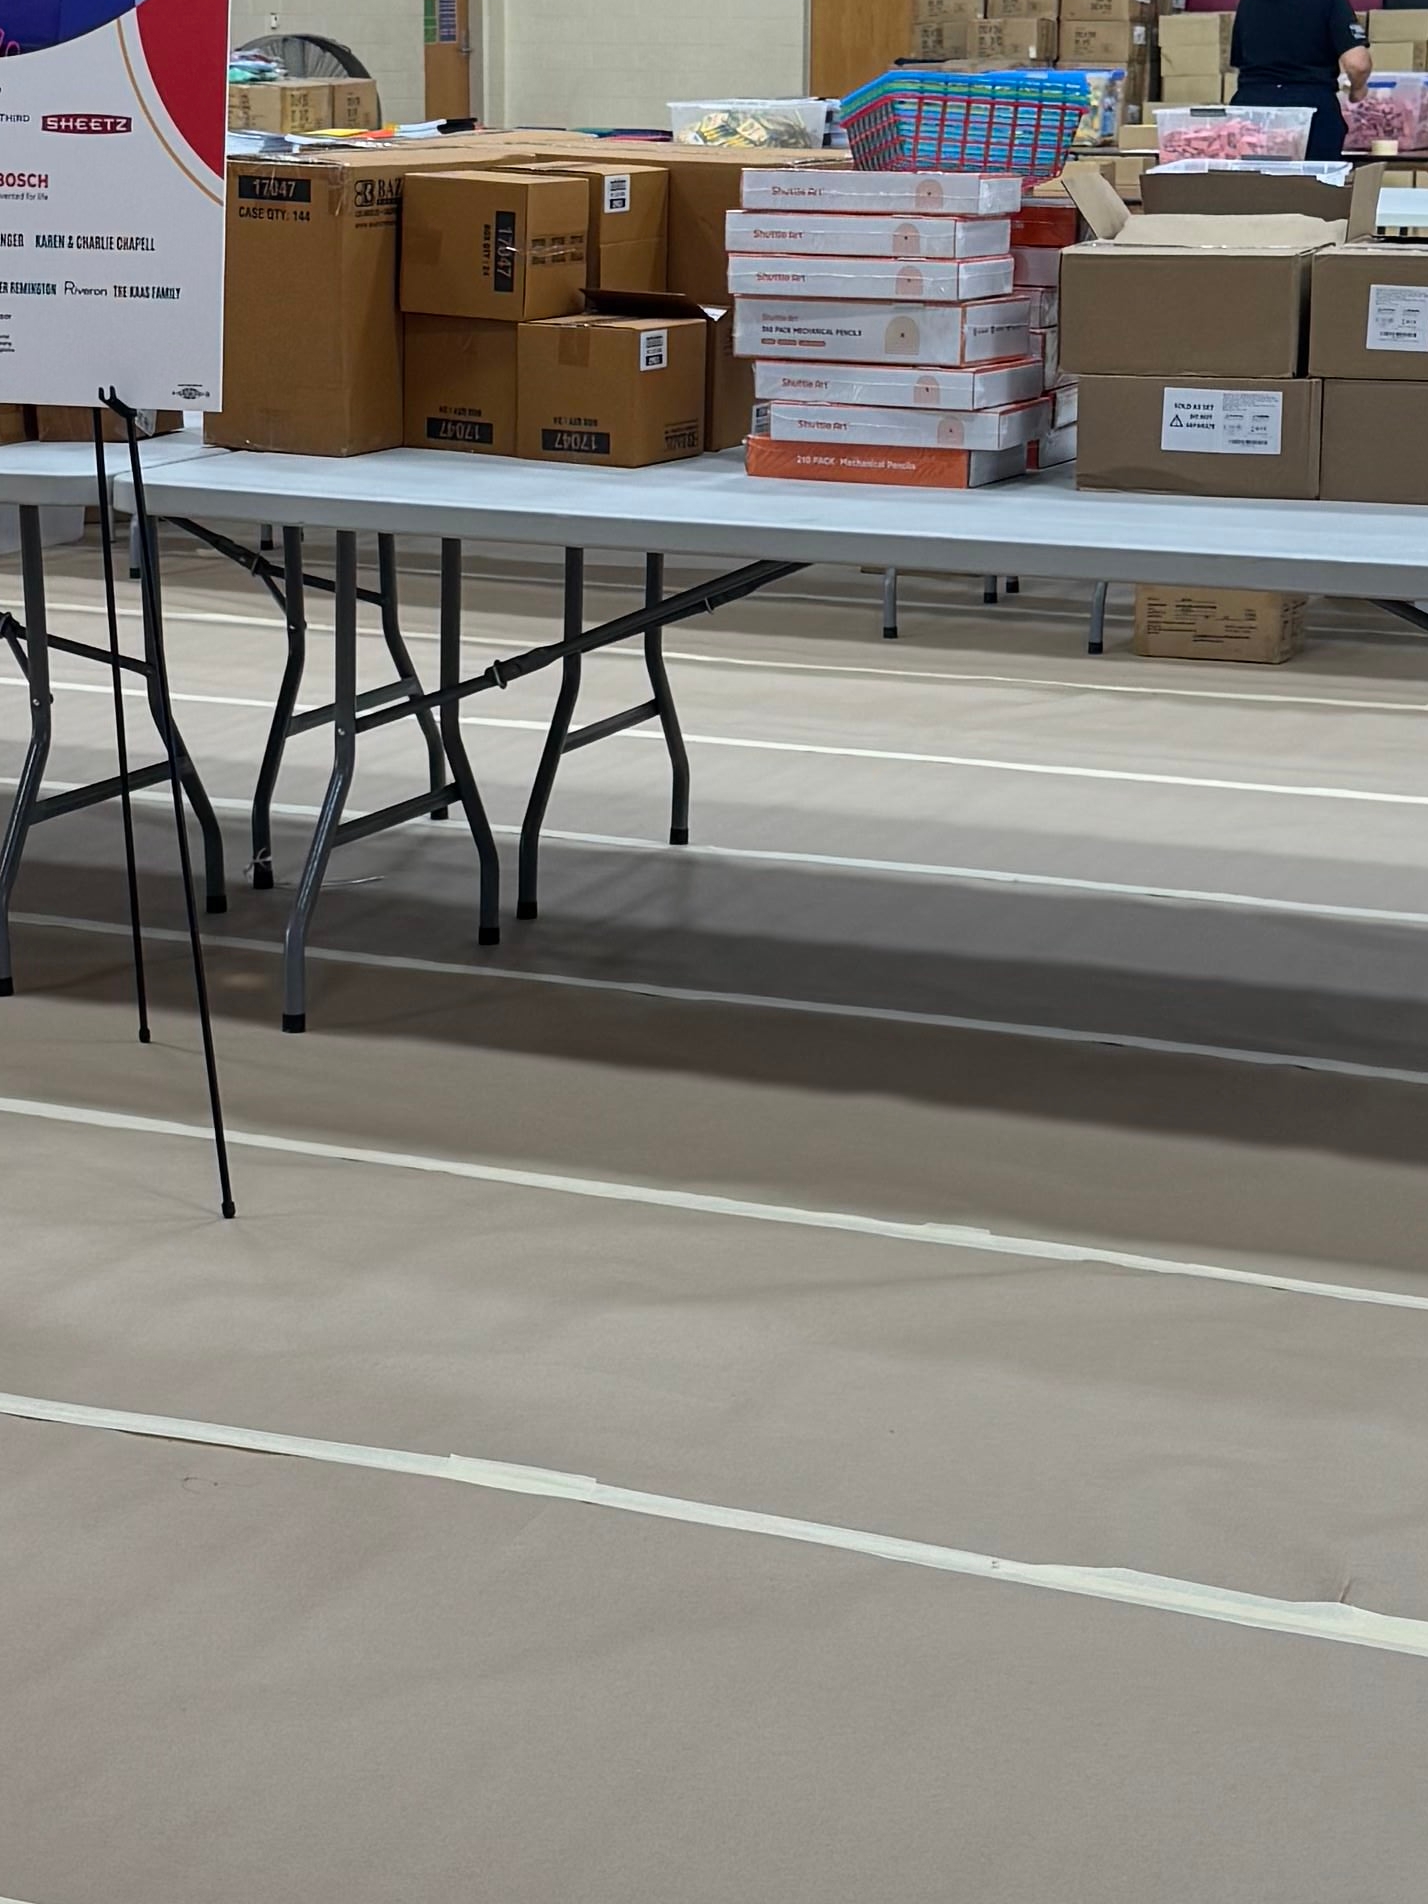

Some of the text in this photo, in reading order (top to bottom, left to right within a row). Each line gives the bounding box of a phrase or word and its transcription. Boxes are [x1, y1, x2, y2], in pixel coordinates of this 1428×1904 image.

[0, 113, 30, 122] THIRD
[46, 117, 127, 131] SHEETZ
[253, 179, 296, 198] 17047
[238, 207, 264, 219] CASE
[293, 210, 310, 222] 144
[35, 234, 156, 251] KAREN & CHARLIE CHAPELL
[64, 280, 108, 296] Riveron
[781, 378, 828, 390] Shuttle Art
[439, 422, 481, 440] 17047
[554, 433, 598, 450] 17047
